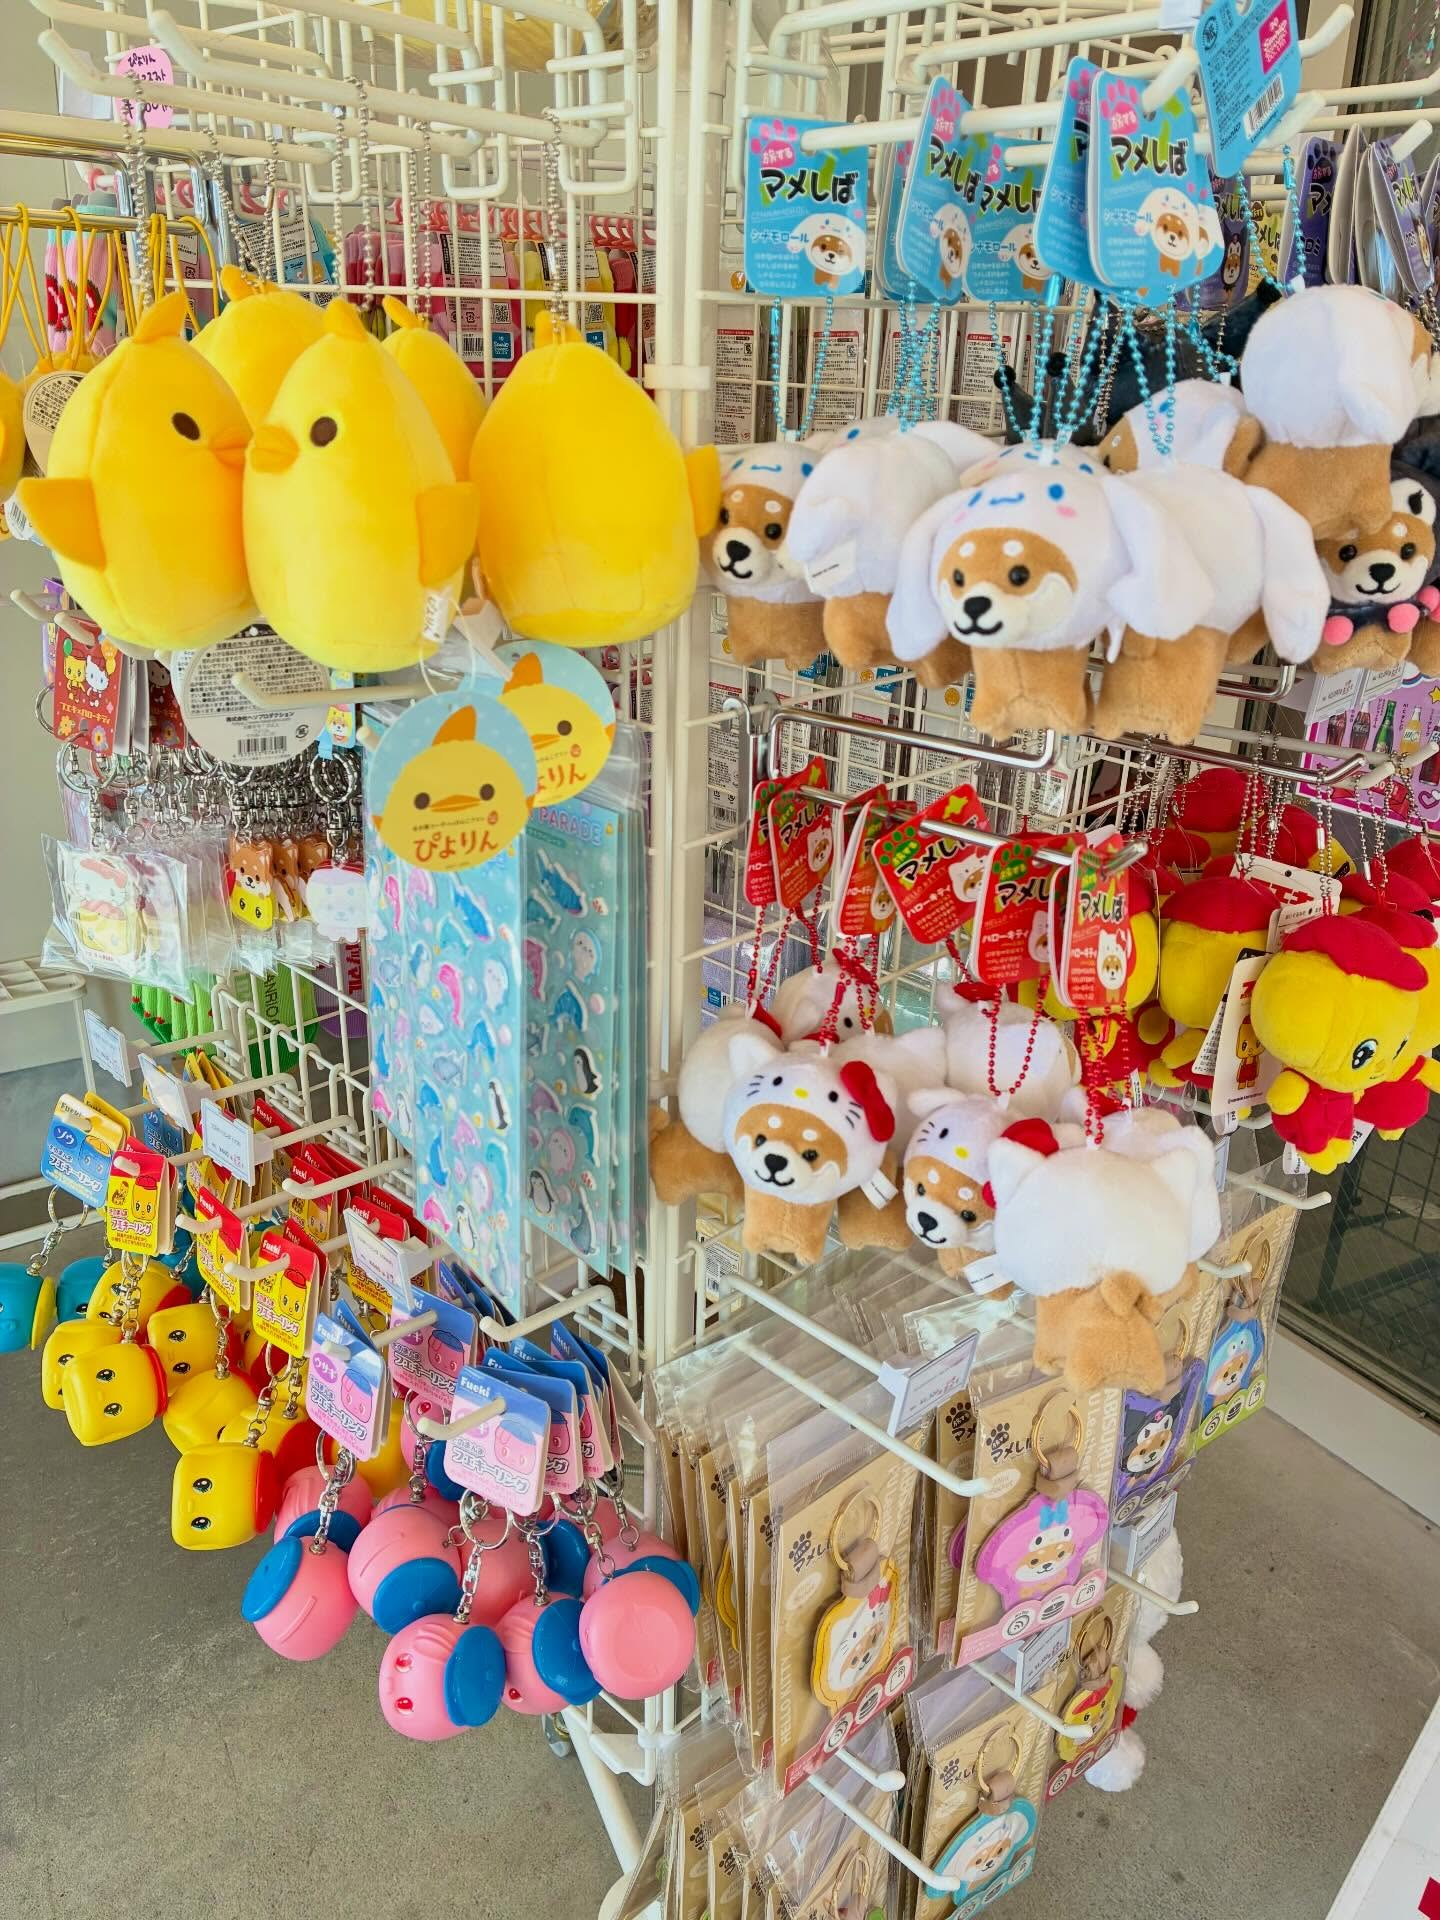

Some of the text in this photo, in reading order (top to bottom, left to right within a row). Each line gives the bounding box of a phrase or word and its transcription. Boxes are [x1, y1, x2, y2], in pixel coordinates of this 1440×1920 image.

[929, 136, 983, 203] マメしば
[1111, 135, 1188, 177] マメしば
[761, 169, 860, 204] マメしば
[979, 183, 1042, 214] マメし
[1104, 209, 1154, 226] シナモロール
[751, 229, 810, 244] シナモロール
[539, 806, 602, 847] PARADE
[413, 829, 499, 863] ぴよりん
[907, 885, 951, 918] ハローキティ
[998, 878, 1050, 907] マメし
[1080, 891, 1125, 923] マメしば
[49, 1156, 102, 1191] フエキーリング
[292, 1165, 307, 1180] Fueki
[352, 1204, 370, 1220] Fueki
[373, 1195, 392, 1211] Fueki
[111, 1219, 153, 1235] フエキーリング
[263, 1239, 281, 1255] Fueki
[257, 1306, 299, 1335] フエキーリング
[460, 1377, 491, 1398] Fueki
[311, 1388, 367, 1439] フエキーリング
[453, 1449, 530, 1494] フエキーリング
[780, 1654, 793, 1745] HELLO KITTY
